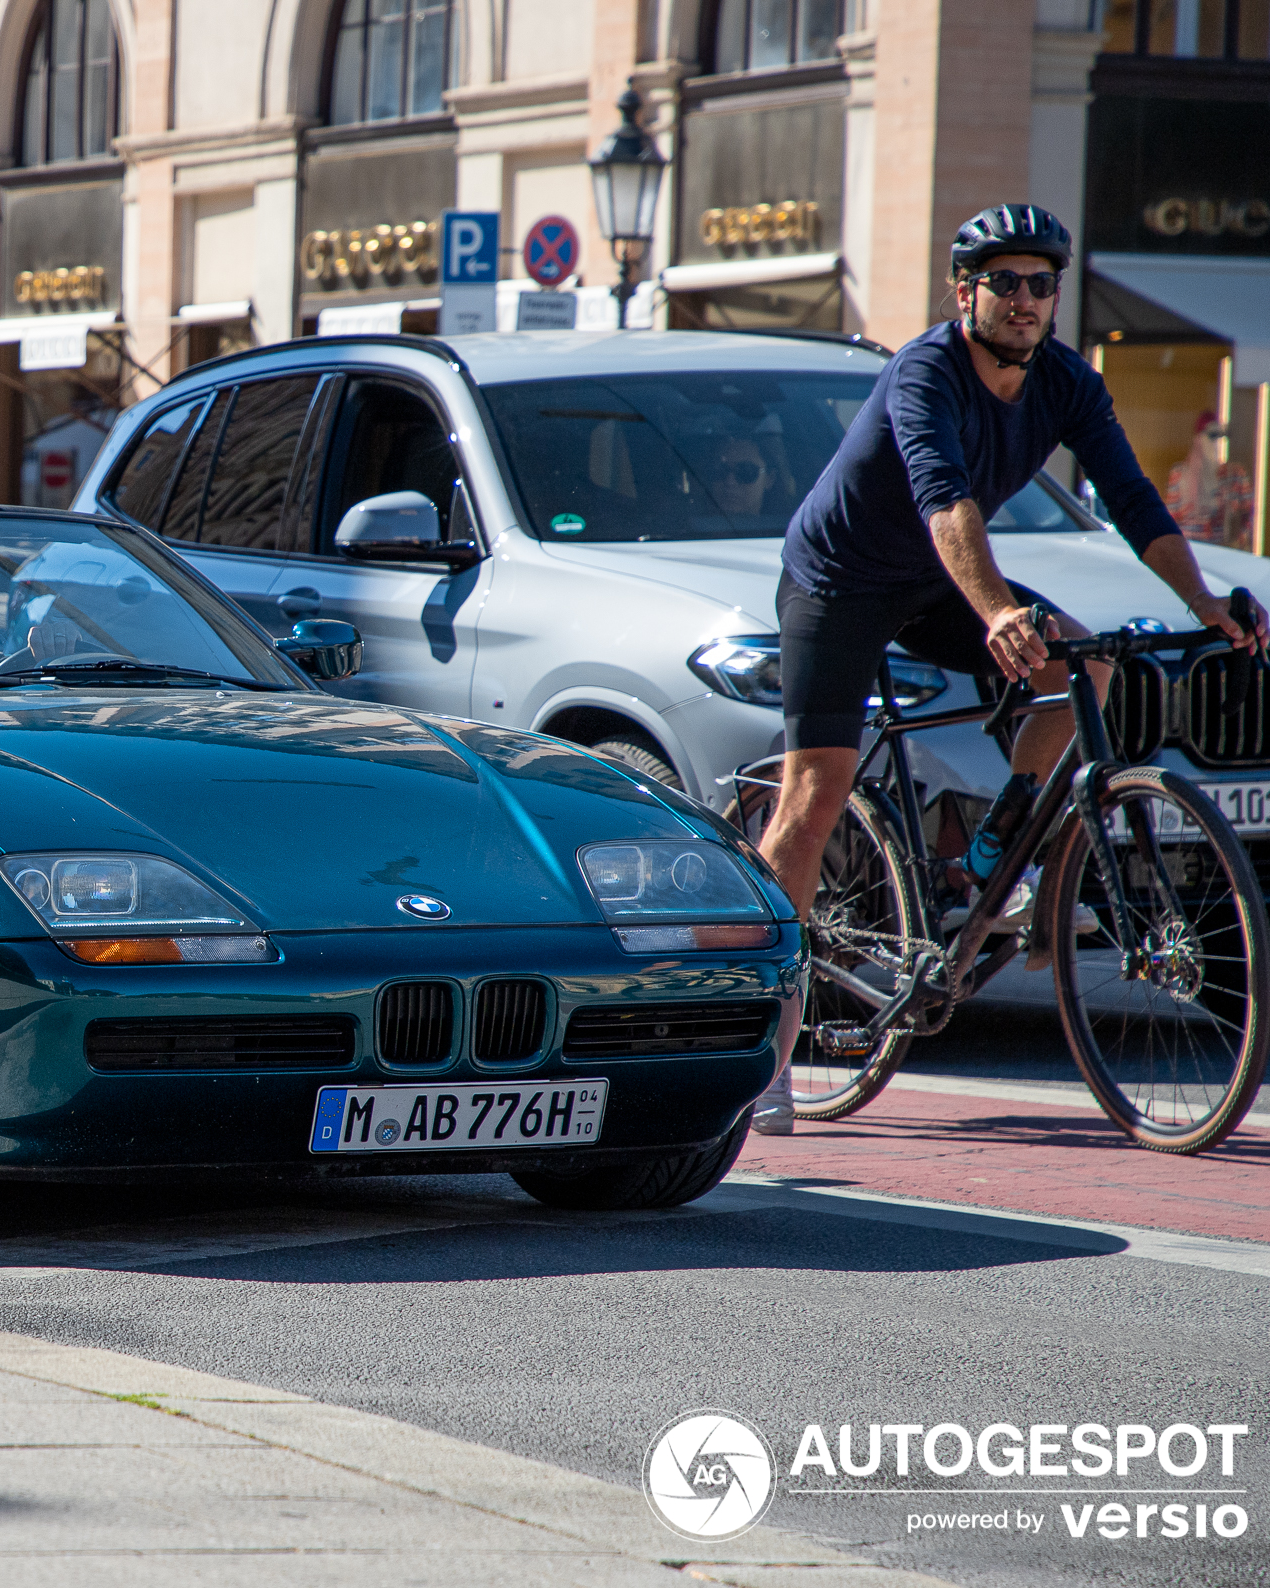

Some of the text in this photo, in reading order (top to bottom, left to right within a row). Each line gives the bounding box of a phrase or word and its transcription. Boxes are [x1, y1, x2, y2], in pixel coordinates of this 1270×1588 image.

[449, 218, 484, 278] P
[579, 1090, 598, 1103] 04
[343, 1091, 576, 1143] M AB 776H
[321, 1126, 333, 1139] D
[575, 1122, 593, 1136] 10
